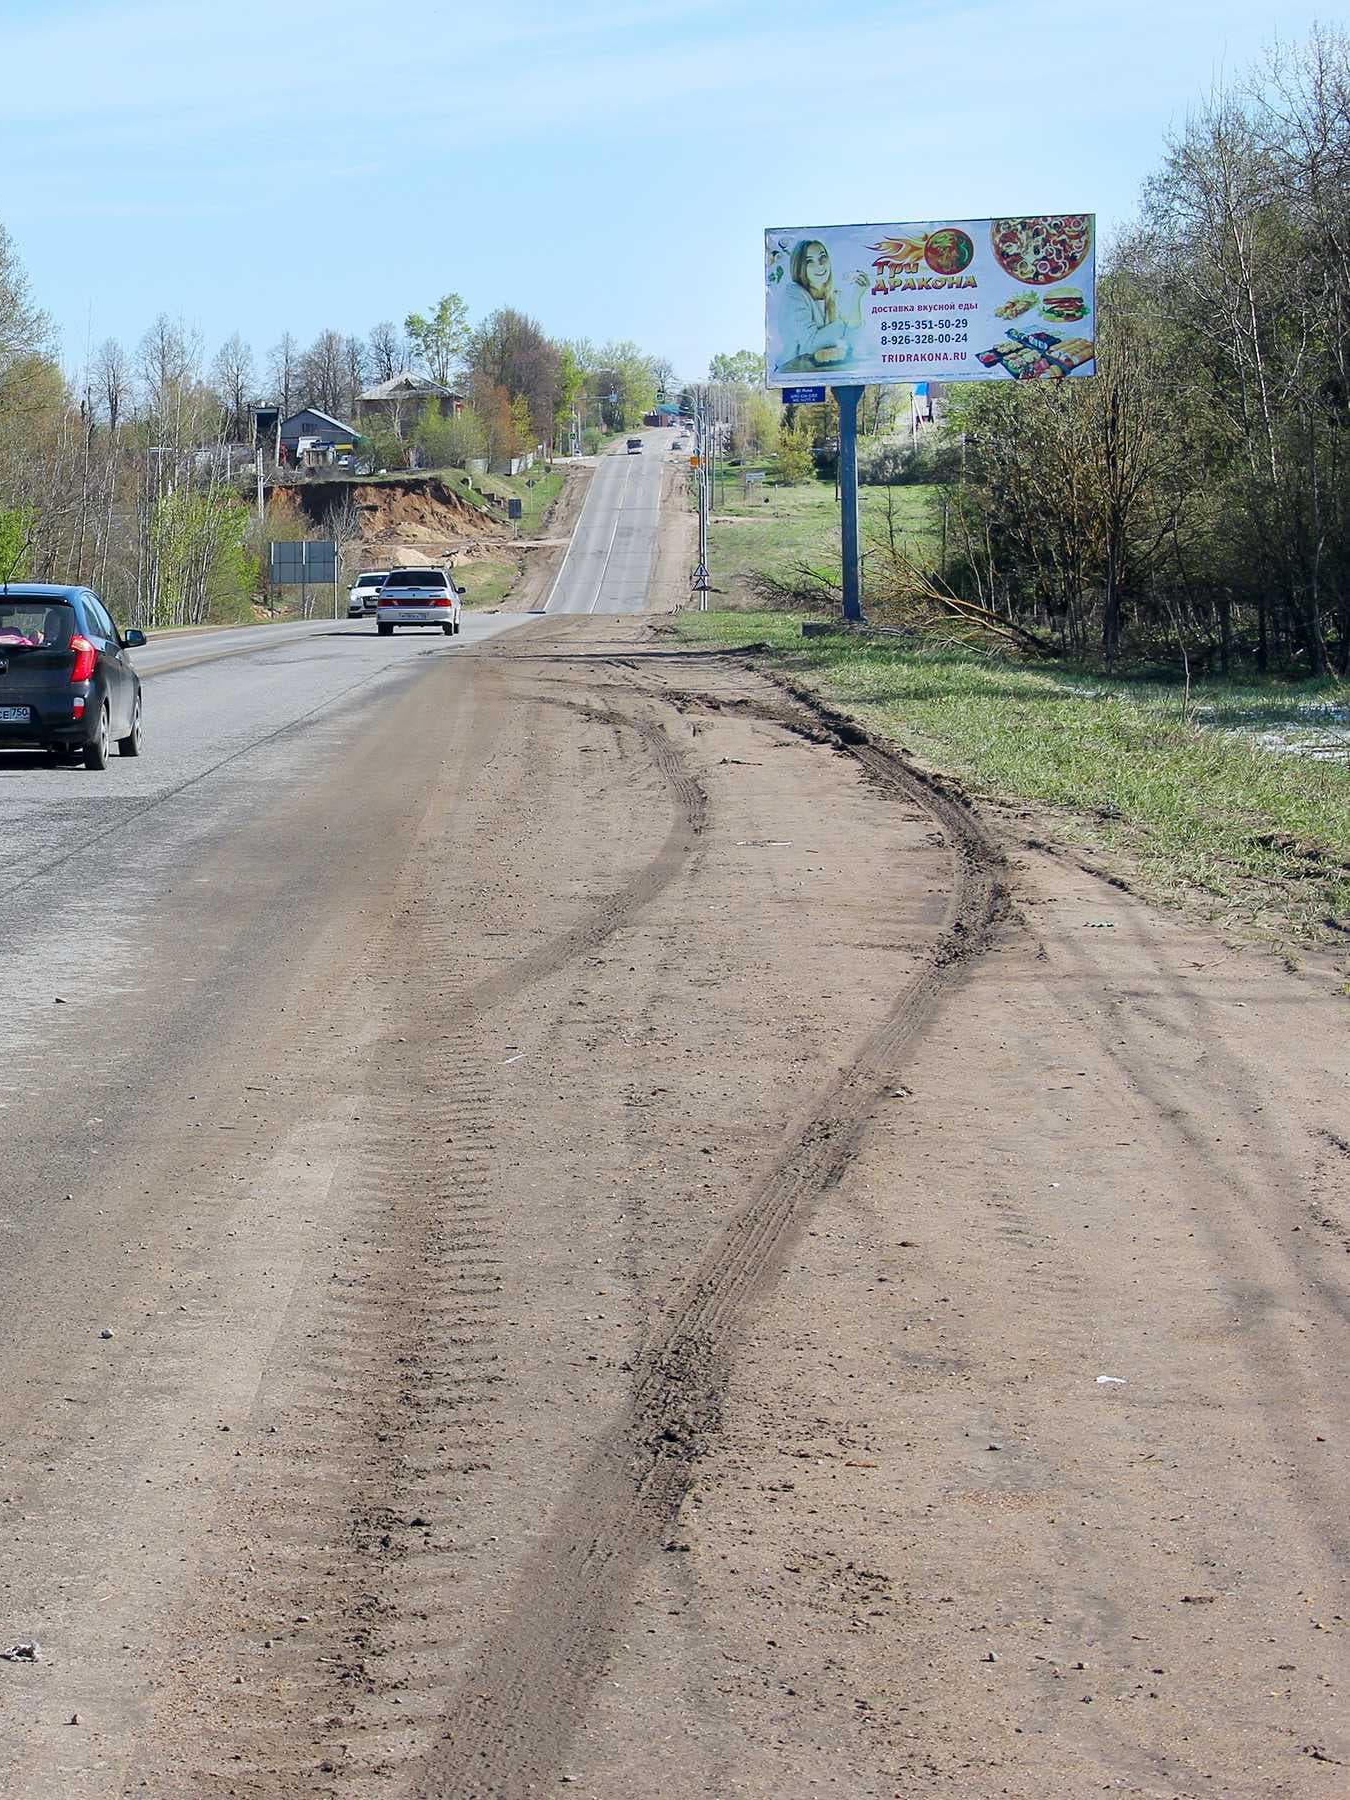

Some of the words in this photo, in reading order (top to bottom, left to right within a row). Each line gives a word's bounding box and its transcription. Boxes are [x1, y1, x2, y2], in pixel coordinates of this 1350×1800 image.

[871, 274, 978, 295] ДРАКОНА
[871, 304, 915, 314] доставка
[917, 301, 956, 313] вкусной
[958, 302, 978, 312] еды
[881, 318, 968, 331] 8-925-351-50-29
[881, 333, 968, 346] 8-926-328-00-24
[881, 351, 967, 363] TRIDRAKONA.RU
